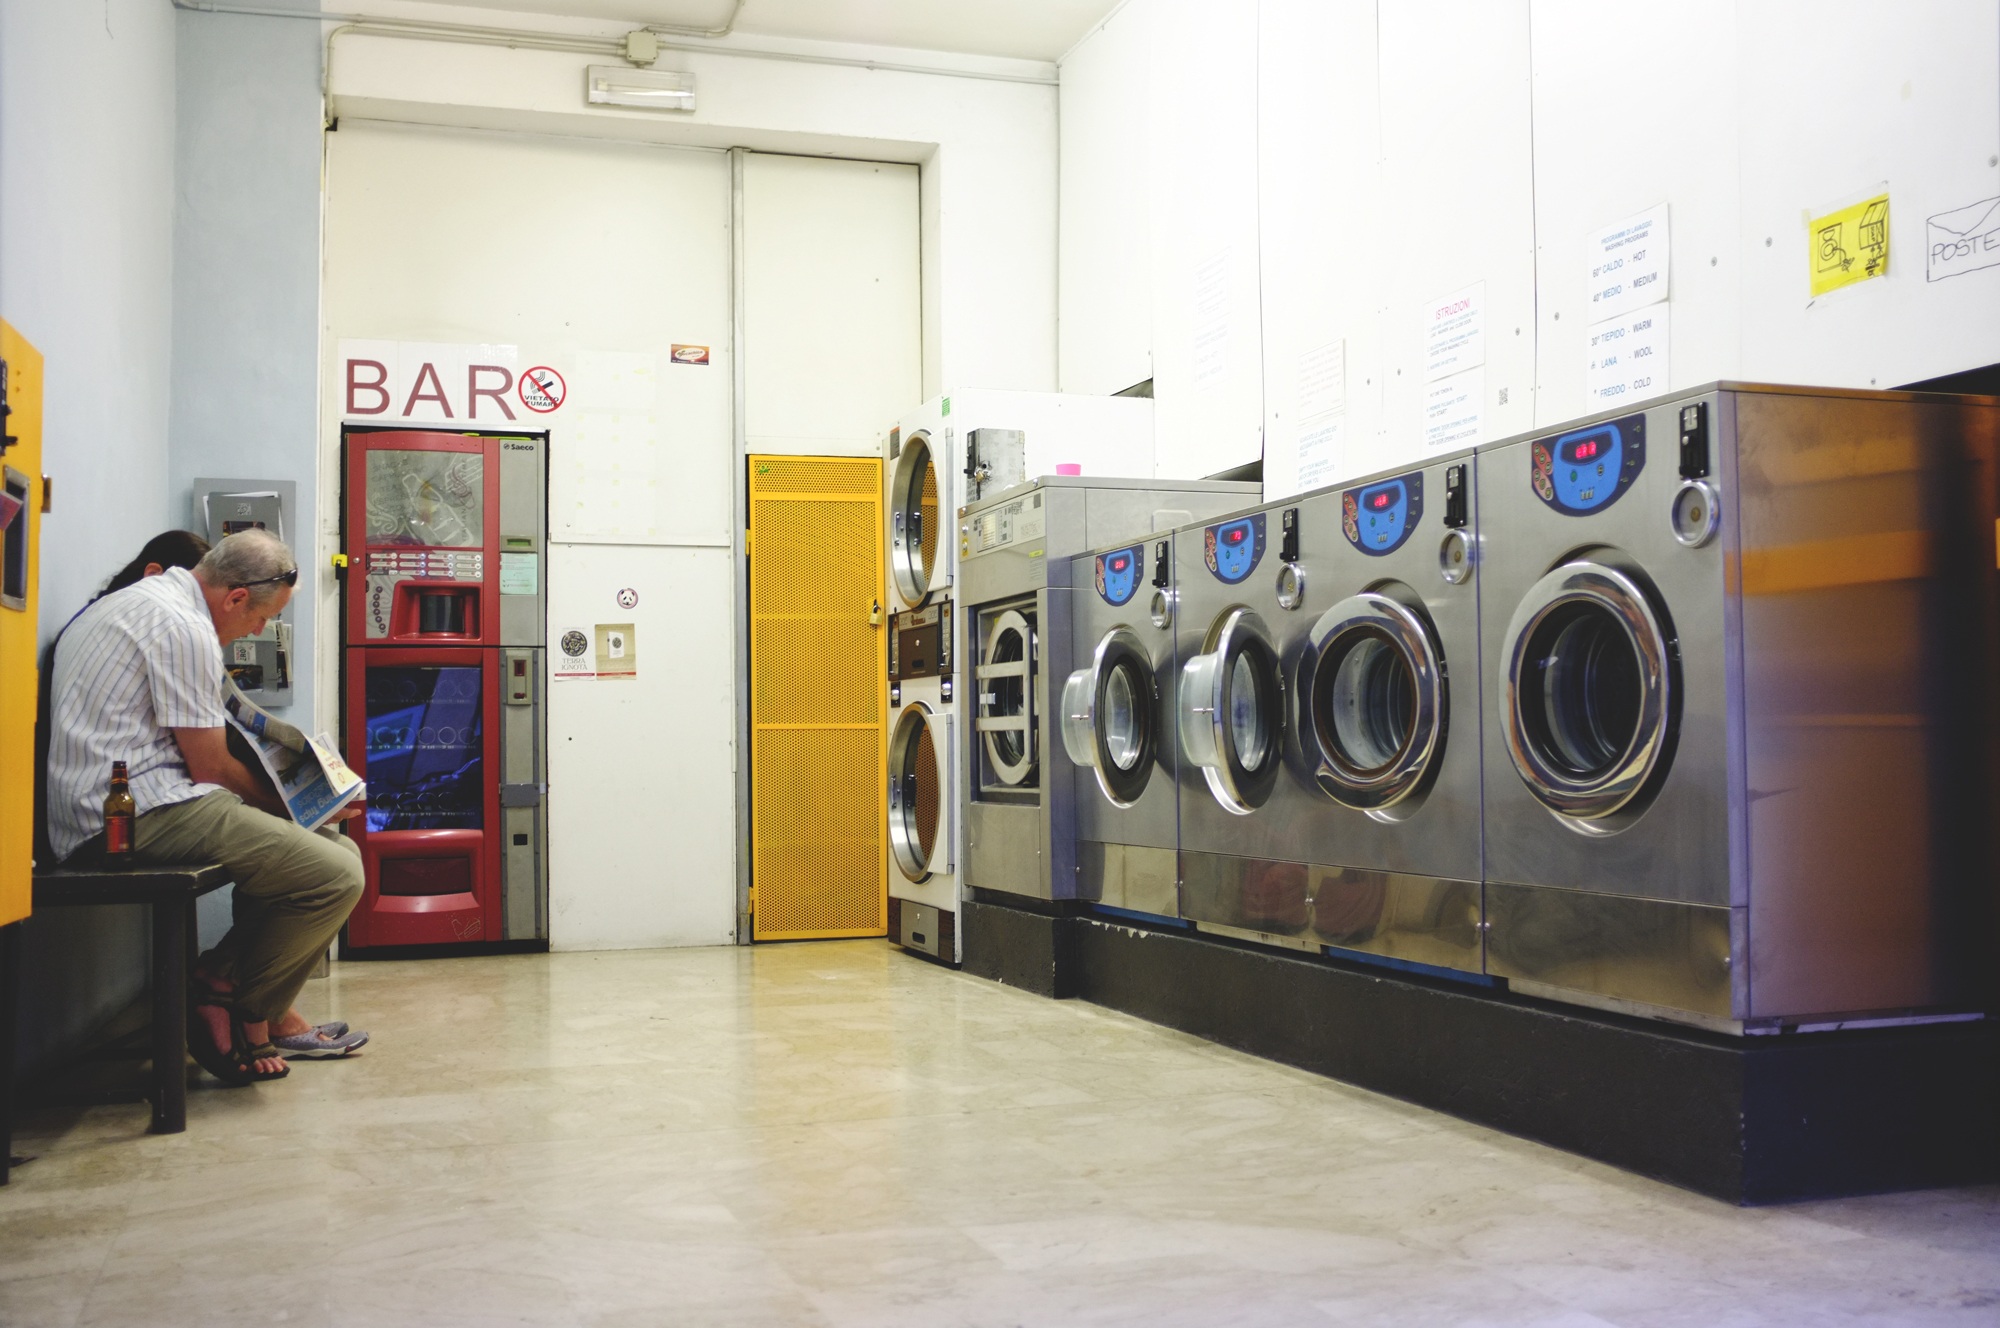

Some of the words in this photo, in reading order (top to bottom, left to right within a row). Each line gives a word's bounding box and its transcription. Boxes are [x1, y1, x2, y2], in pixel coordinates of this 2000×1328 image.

[1931, 228, 2000, 265] POSTE
[1602, 259, 1623, 274] CALDO
[1633, 250, 1646, 263] HOT
[1602, 285, 1622, 299] MEDIO
[1633, 272, 1657, 288] MEDIUM
[1436, 298, 1470, 320] ISTRUZIONI
[1601, 328, 1625, 343] TIEPIDO
[1632, 319, 1652, 334] WARM
[1601, 356, 1617, 368] LANA
[1634, 346, 1653, 359] WOOL
[346, 359, 517, 420] BAR
[1600, 383, 1625, 398] FREDDO
[1634, 377, 1651, 390] COLD
